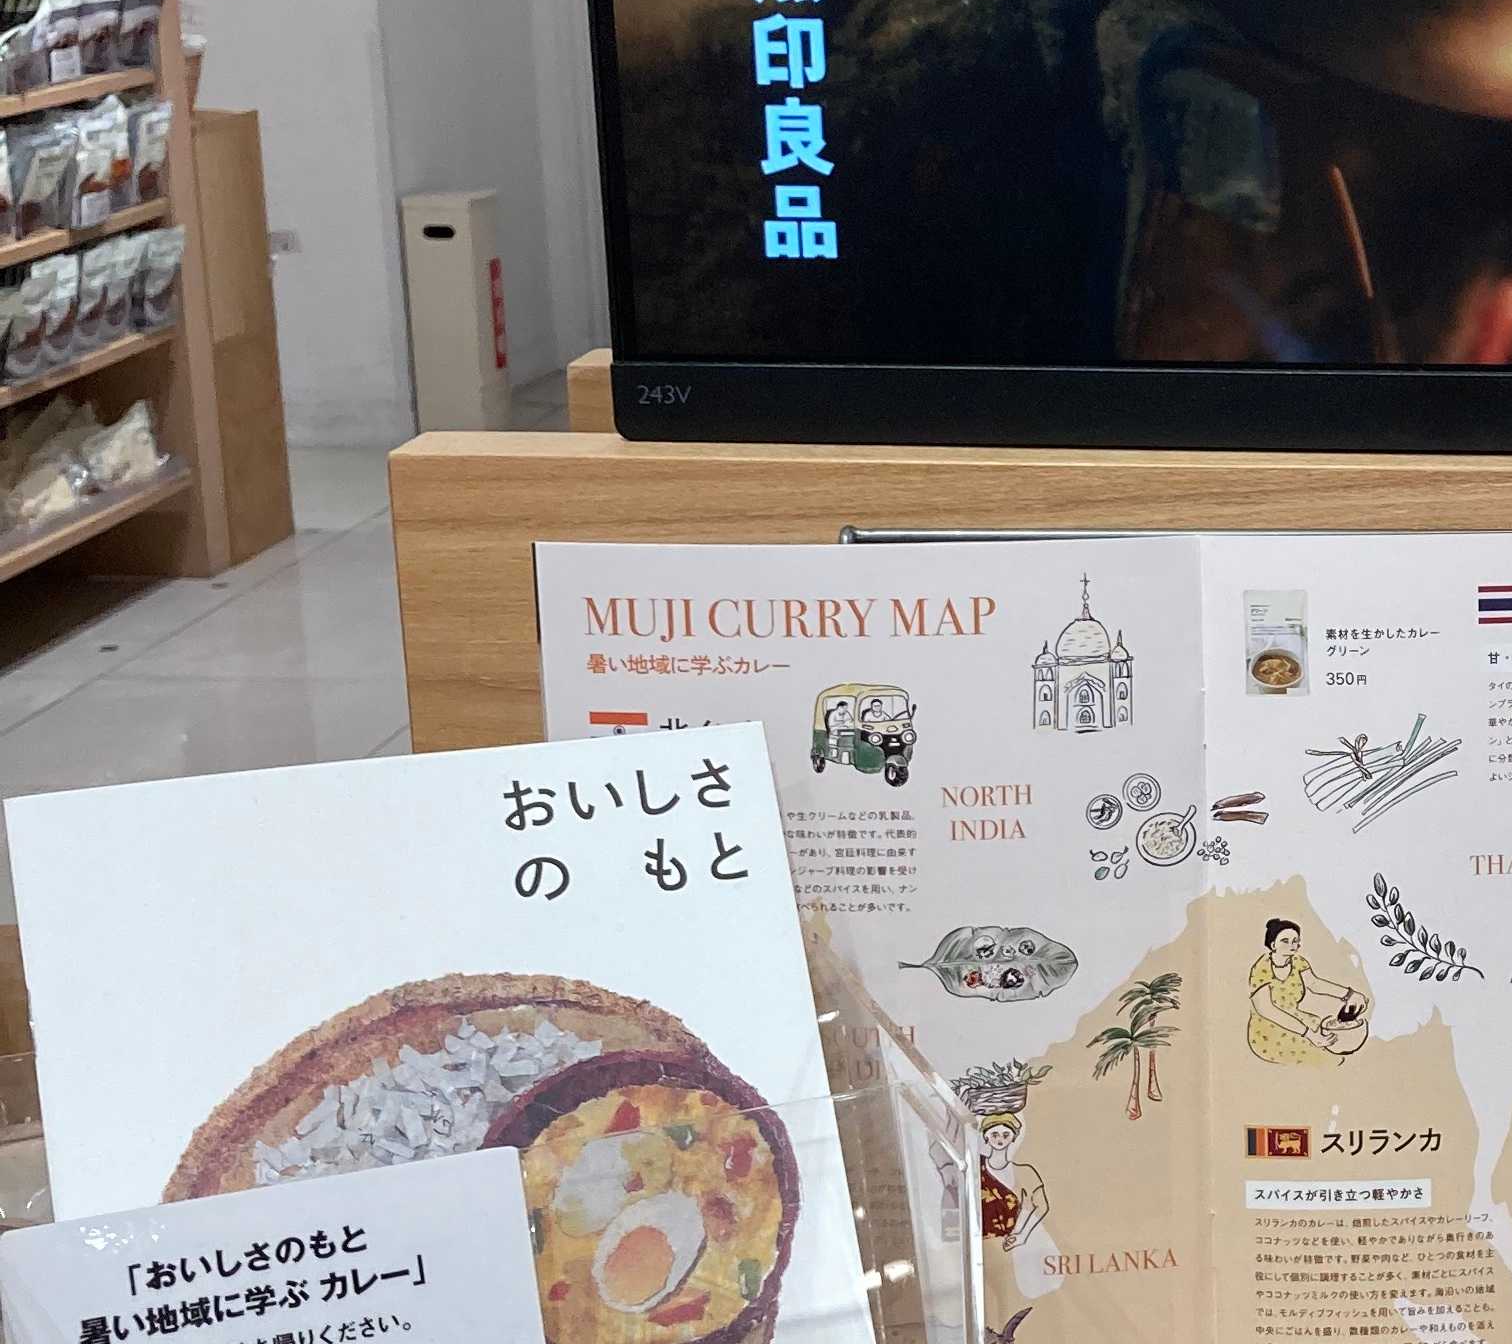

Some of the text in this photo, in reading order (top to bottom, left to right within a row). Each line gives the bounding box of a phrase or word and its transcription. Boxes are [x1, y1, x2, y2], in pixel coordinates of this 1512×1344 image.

[638, 385, 691, 405] 243V
[584, 596, 997, 643] MUJI CURRY MAP
[1326, 628, 1441, 641] 素材を生かしたカレー
[586, 653, 790, 675] 暑い地域に学ぶカレー
[1326, 646, 1370, 657] グリーン
[1325, 671, 1368, 687] 350円
[503, 757, 735, 832] おいしさ
[942, 784, 1032, 809] NORTH
[950, 818, 1026, 841] INDIA
[514, 831, 749, 901] の もと
[1321, 1128, 1442, 1156] スリランカ
[1254, 1187, 1424, 1203] スパイスが引き立つ軽やかさ
[127, 1224, 369, 1296] 「おいしさのもと
[1043, 1247, 1179, 1276] SRI LANKA
[320, 1254, 428, 1302] カレー」
